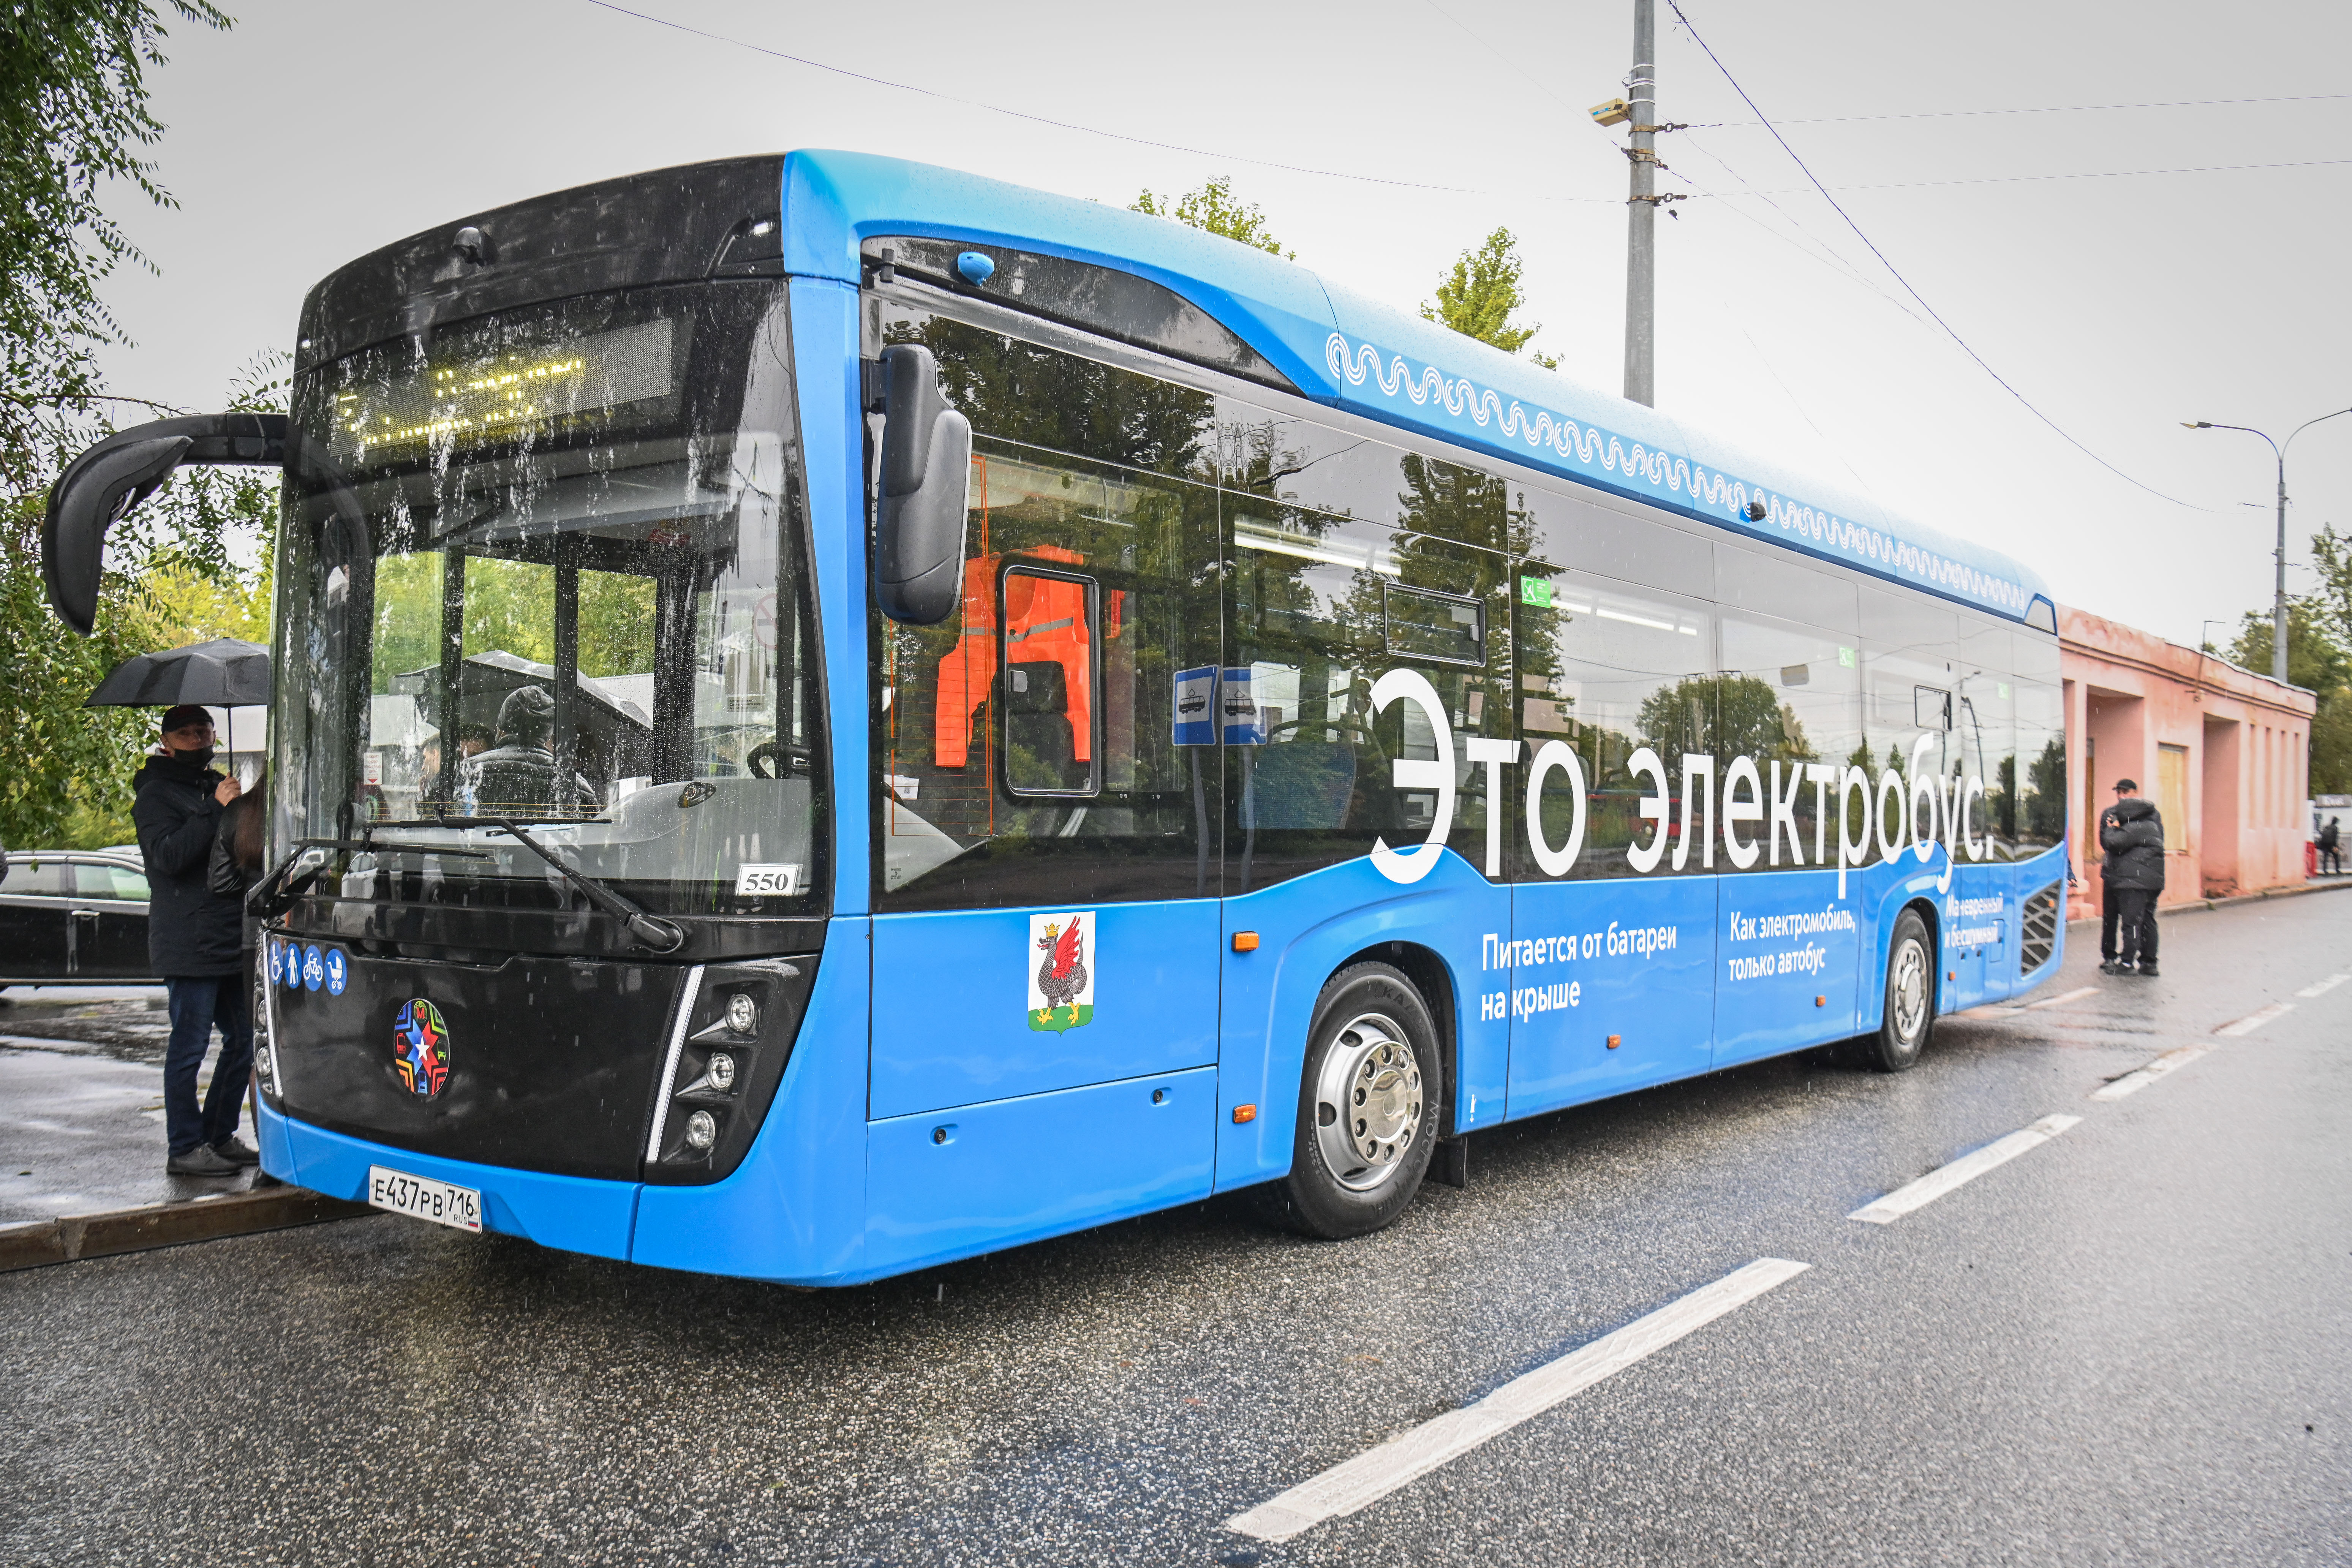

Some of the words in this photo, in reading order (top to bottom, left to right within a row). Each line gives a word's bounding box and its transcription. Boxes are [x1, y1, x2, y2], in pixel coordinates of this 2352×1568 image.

[1369, 668, 1586, 884] Это
[1626, 731, 1994, 899] электробус.
[745, 874, 788, 890] 550
[1730, 911, 1756, 941] Как
[1759, 903, 1856, 941] электромобиль,
[1483, 933, 1577, 970] Питается
[1582, 933, 1603, 959] от
[1607, 921, 1677, 959] батареи
[1728, 954, 1775, 981] только
[1778, 941, 1826, 976] автобус
[1481, 991, 1506, 1021] на
[1513, 981, 1581, 1023] крыше
[375, 1176, 443, 1217] Е437РВ
[447, 1189, 474, 1216] 716
[454, 1214, 468, 1225] RUS
